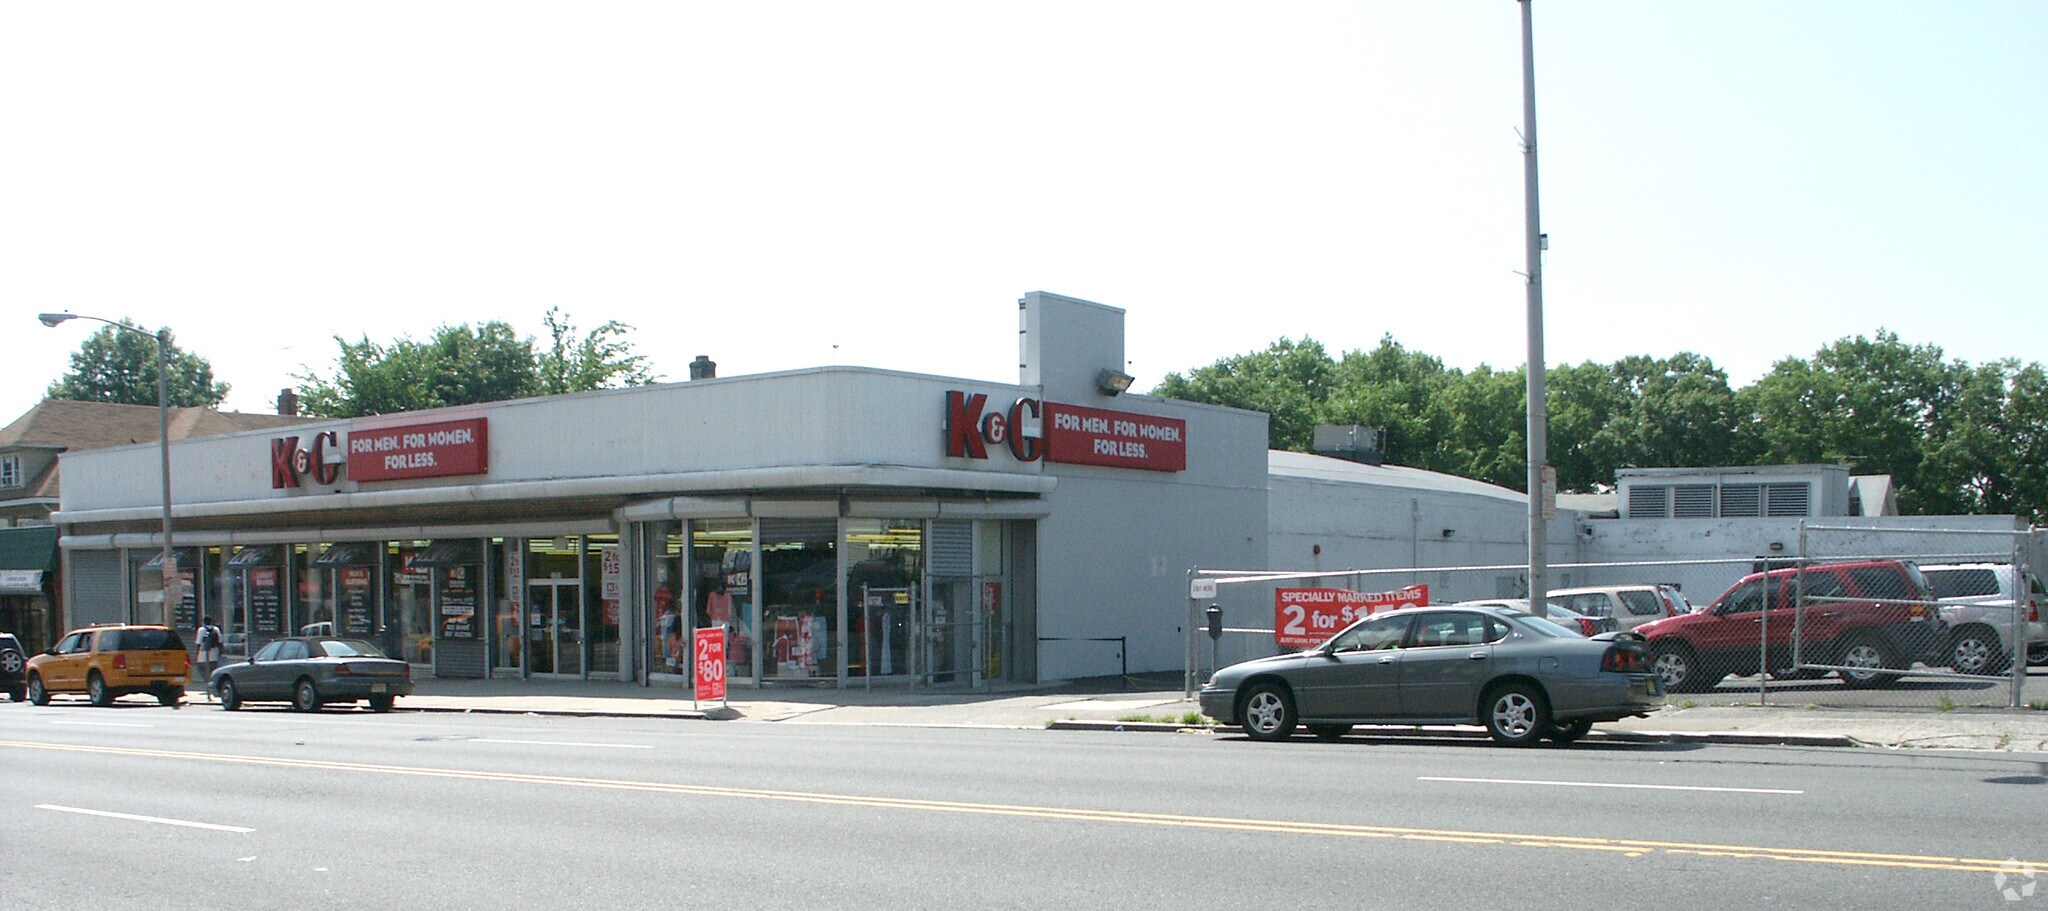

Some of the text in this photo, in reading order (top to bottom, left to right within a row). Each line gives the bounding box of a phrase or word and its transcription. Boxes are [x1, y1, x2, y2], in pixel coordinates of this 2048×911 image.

[946, 390, 1043, 462] K&G
[1055, 413, 1182, 442] FOR MEN. FOR WOMEN.
[352, 428, 474, 453] FOR MEN. FOR WOMEN.
[1094, 439, 1148, 458] FOR LESS.
[271, 430, 340, 488] K&G
[384, 452, 437, 470] FOR LESS.
[1282, 591, 1336, 602] SPECIALLY
[1337, 592, 1383, 603] MARKED
[1283, 604, 1306, 635] 2
[1311, 610, 1338, 628] for
[698, 639, 721, 660] 2 FOR
[699, 659, 723, 682] $80
